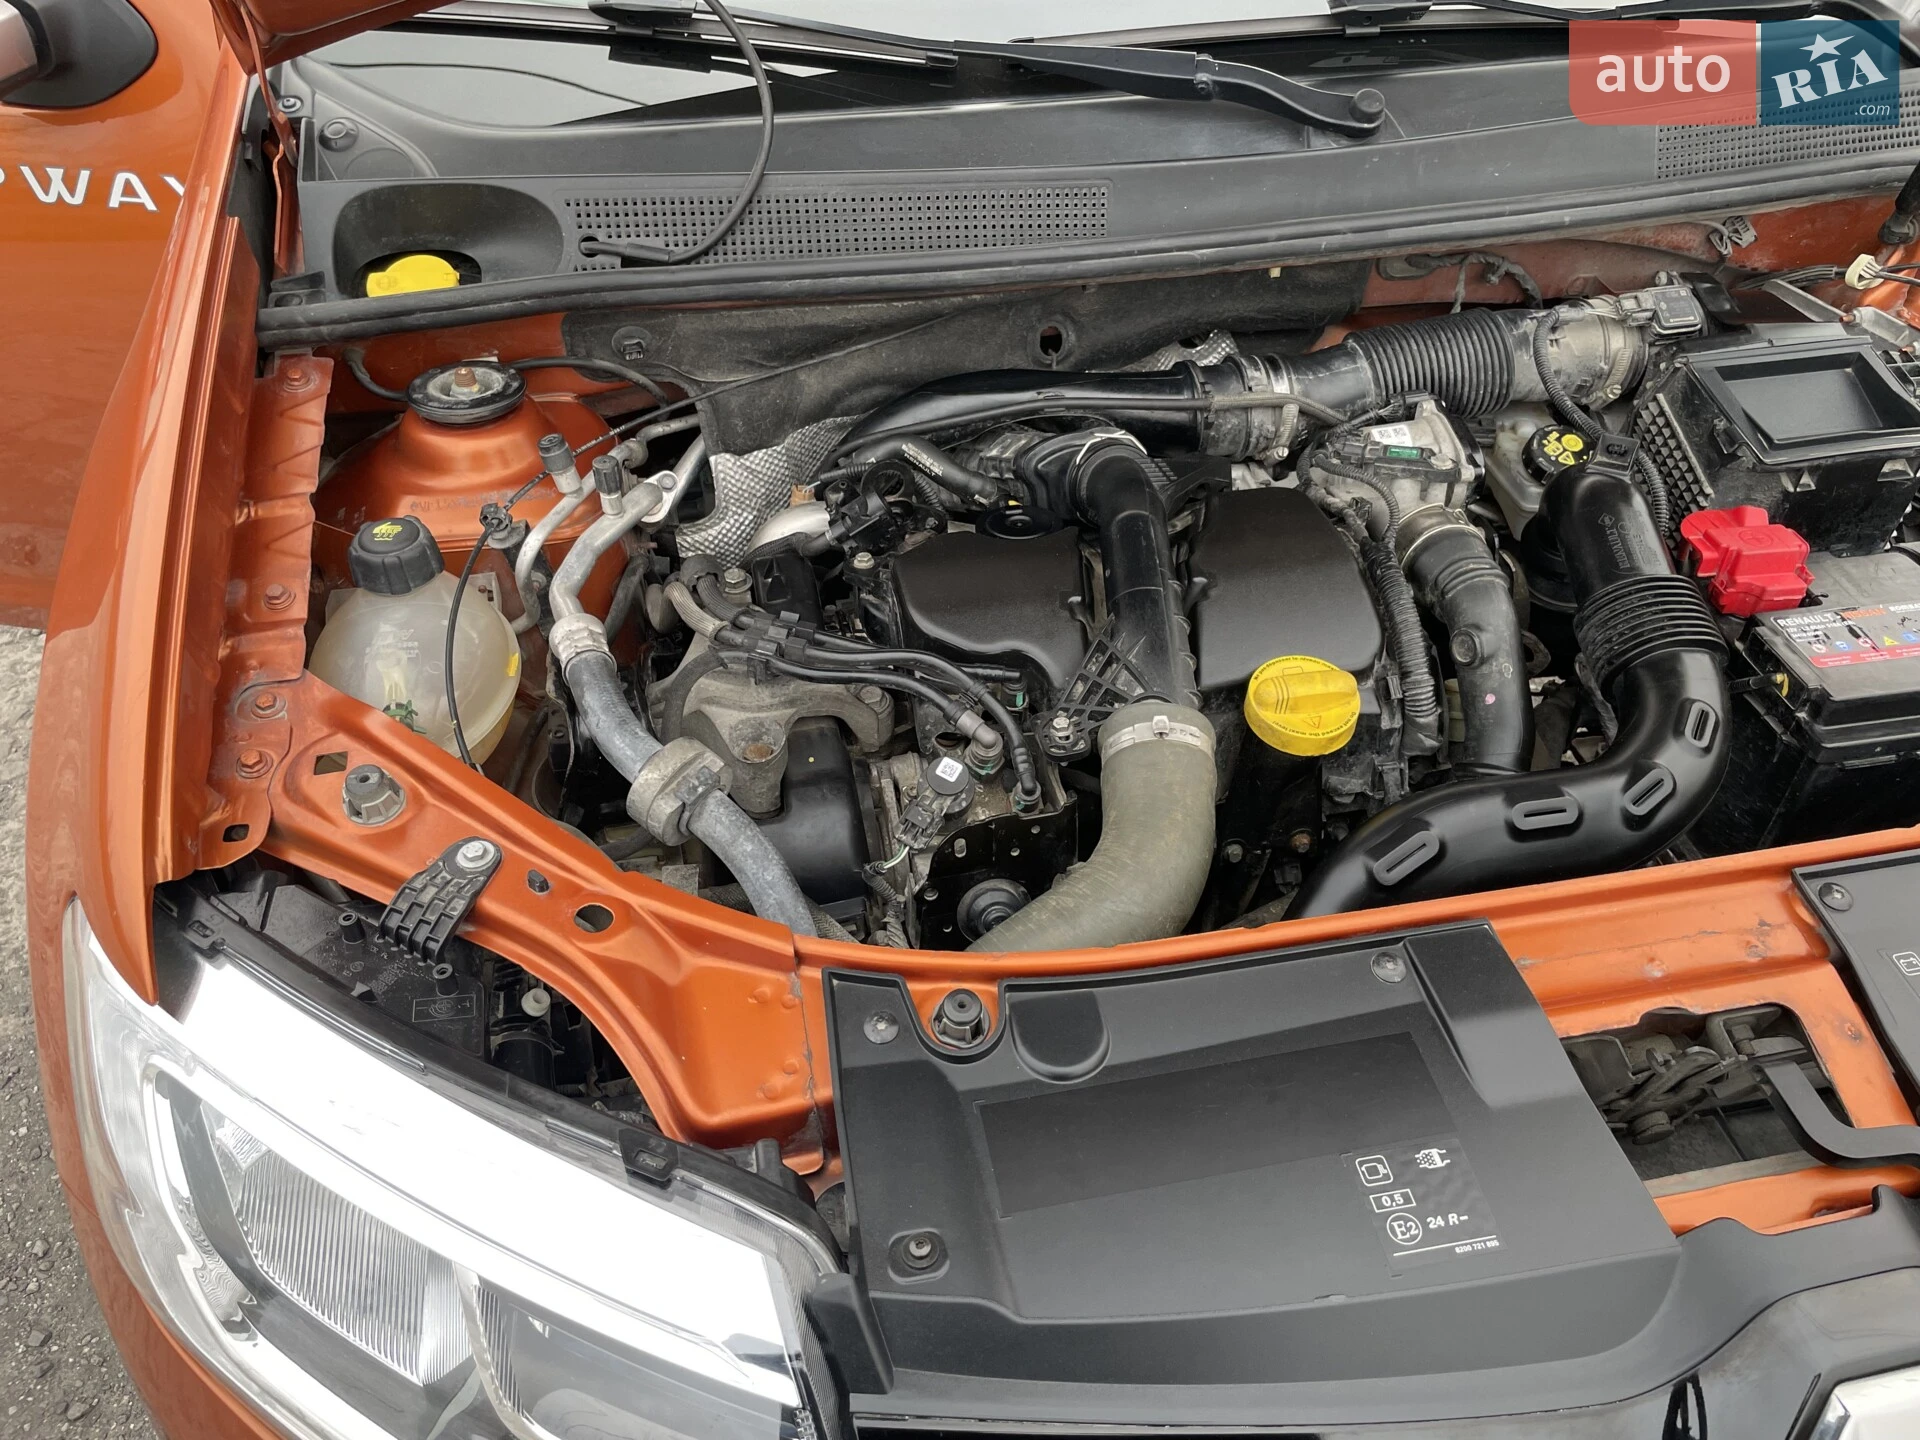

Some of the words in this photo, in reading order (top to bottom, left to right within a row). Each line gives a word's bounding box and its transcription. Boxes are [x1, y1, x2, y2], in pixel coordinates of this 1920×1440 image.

[904, 452, 936, 477] RENAULT
[1776, 613, 1835, 627] RENAULT
[1349, 711, 1356, 719] Do
[1272, 721, 1289, 731] level
[1343, 719, 1351, 727] not
[1321, 724, 1343, 736] exceed
[1381, 1193, 1404, 1207] 0,5
[1390, 1220, 1419, 1240] E2
[1426, 1215, 1445, 1229] 24
[1472, 1241, 1485, 1251] 721
